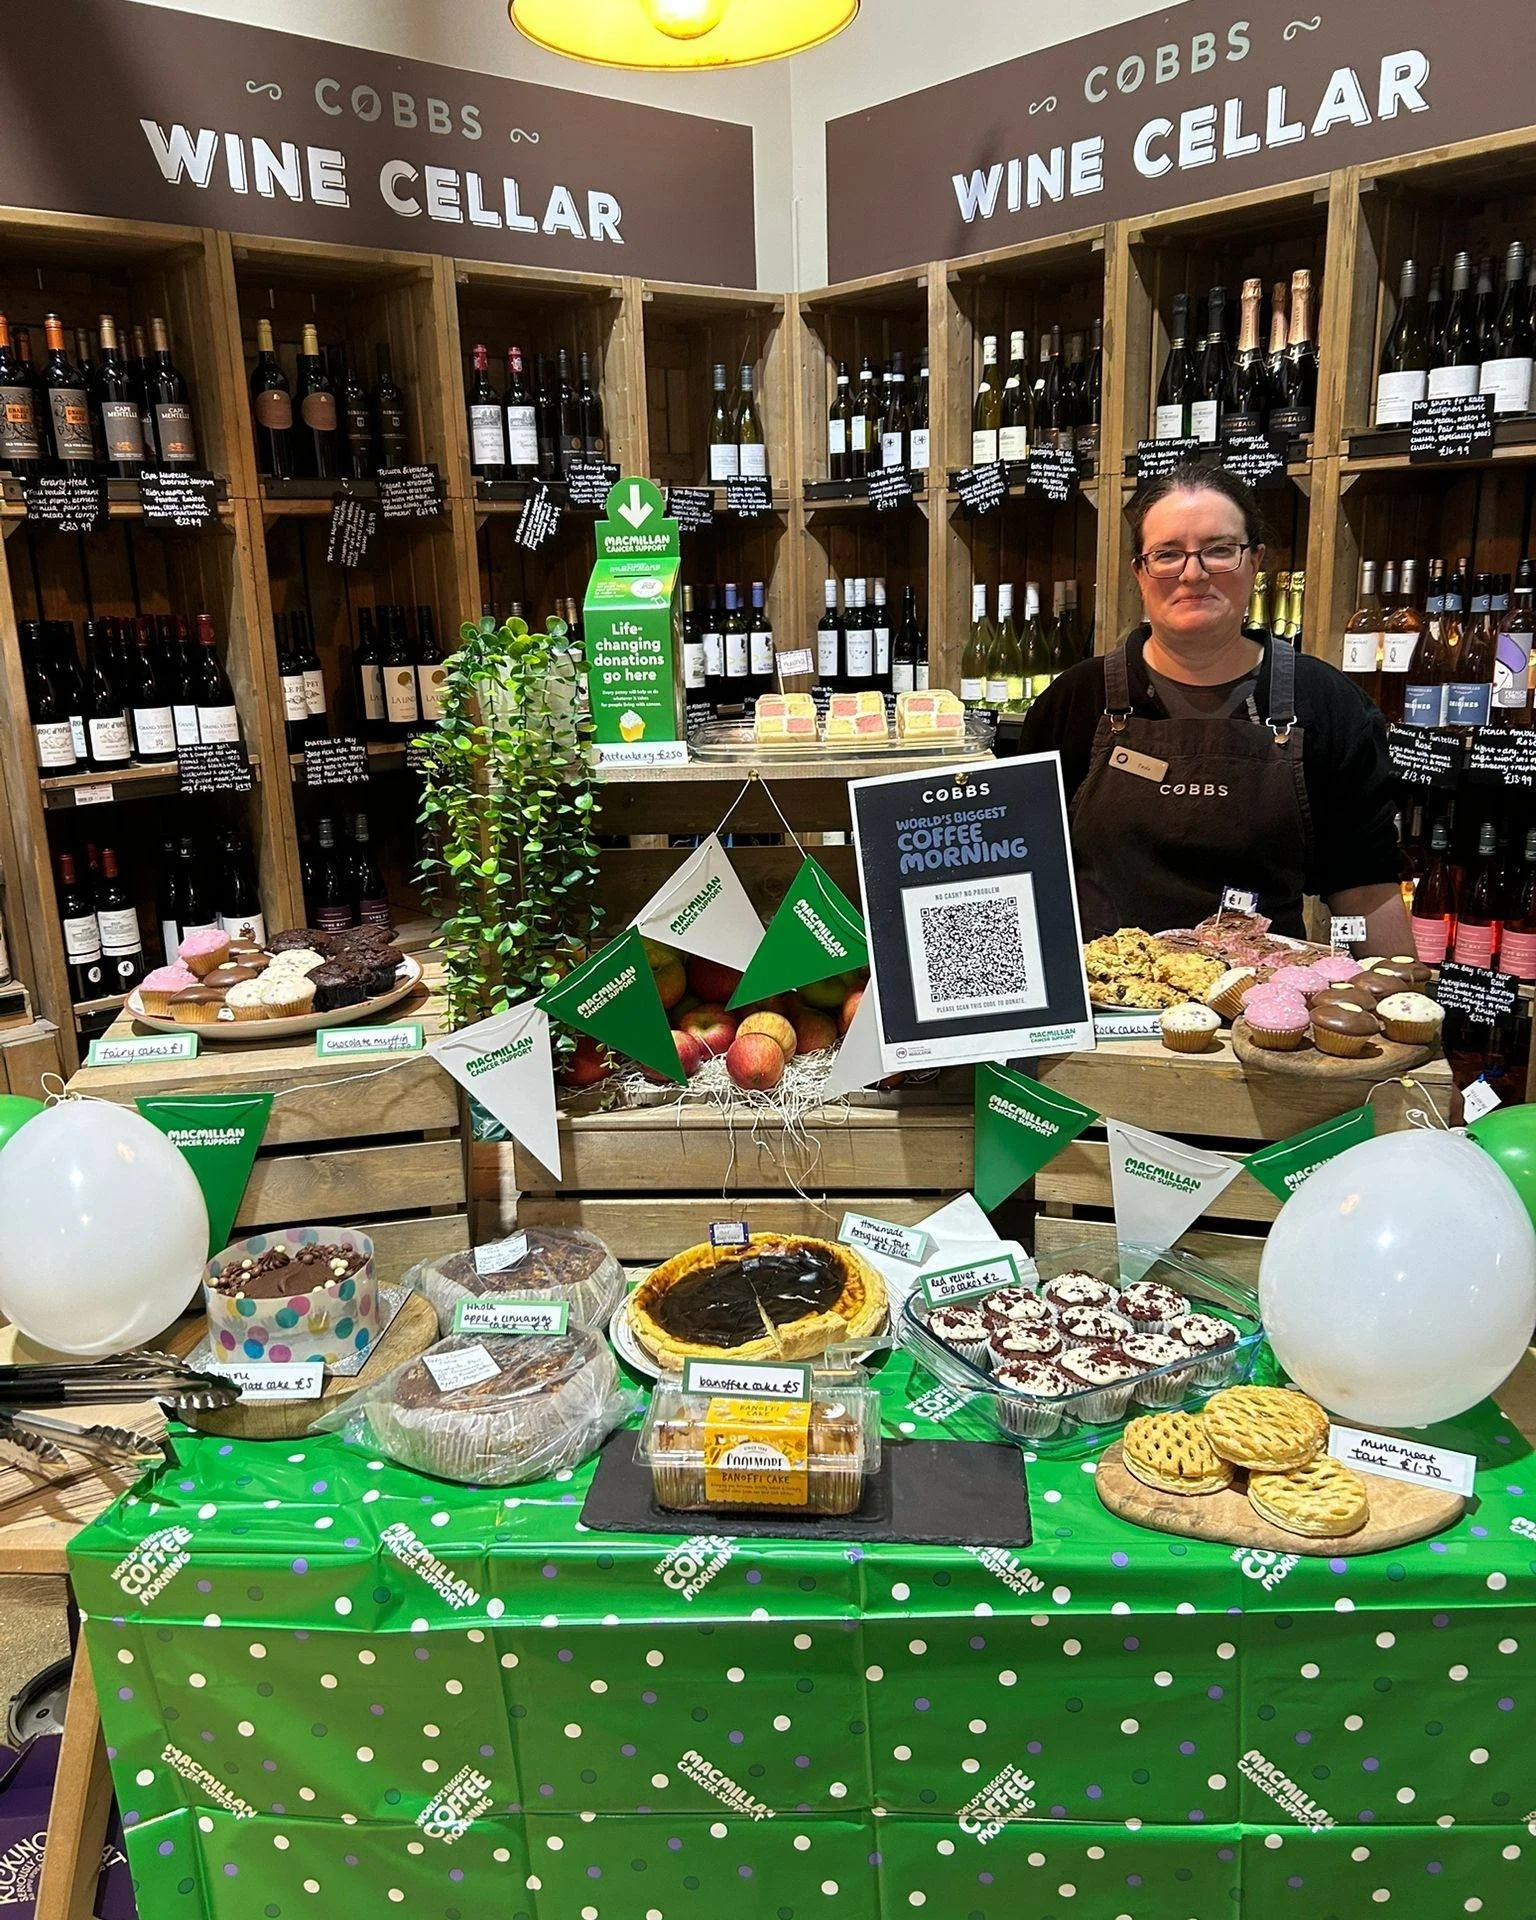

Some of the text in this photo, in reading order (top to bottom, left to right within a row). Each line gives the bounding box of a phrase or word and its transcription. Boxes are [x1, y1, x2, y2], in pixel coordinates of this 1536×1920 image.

[1084, 21, 1251, 104] COBBS
[314, 77, 483, 142] COBBS
[951, 48, 1431, 224] WINE CELLAR
[139, 117, 626, 245] WINE CELLAR
[604, 534, 670, 547] MACMILLAN
[606, 544, 667, 553] CANCER SUPPORT
[595, 637, 661, 653] changing
[611, 622, 642, 635] Life-
[594, 653, 664, 667] donations
[603, 668, 656, 684] go here
[1414, 740, 1433, 751] Rosé
[922, 783, 990, 803] COBBS
[1159, 783, 1229, 797] COBBS
[896, 805, 1007, 831] WORLD'S BIGGEST
[897, 822, 983, 852] COFFEE
[900, 838, 1028, 875] MORNING
[670, 876, 722, 933] MACMILLAN
[677, 885, 724, 936] CANCER SUPPORT
[792, 905, 839, 958] CANCER SUPPORT
[796, 899, 848, 958] MACMILLAN
[576, 965, 636, 1015] MACMILLAN
[583, 974, 637, 1020] CANCER SUPPORT
[937, 1004, 955, 1013] PLEASE
[956, 1003, 970, 1011] SCAN
[971, 1002, 982, 1010] THIS
[983, 1001, 997, 1009] CODE
[327, 1036, 371, 1050] chocolate
[1029, 1028, 1076, 1039] MACMILLAN
[1117, 1024, 1149, 1035] cakes
[100, 1047, 135, 1064] fairy
[138, 1045, 168, 1059] cakes
[466, 1036, 534, 1072] MACMILLAN
[471, 1044, 533, 1078] CANCER SUPPORT
[987, 1102, 1053, 1138] CANCER SUPPORT
[989, 1094, 1059, 1134] MACMILLAN
[168, 1127, 245, 1140] MACMILLAN
[203, 1135, 241, 1147] SUPPORT
[1124, 1166, 1196, 1195] CANCER SUPPORT
[1125, 1157, 1202, 1190] MACMILLAN
[860, 1218, 904, 1238] Homemade
[931, 1270, 976, 1288] Red velvet
[464, 1315, 490, 1326] apple
[490, 1321, 518, 1331] cake
[266, 1380, 290, 1390] cake
[699, 1375, 801, 1394] banoffee cake £5
[740, 1405, 781, 1413] BANOFFI
[721, 1472, 791, 1484] BANOFFI CAKE
[1350, 1448, 1442, 1478] tart £1.50
[120, 1526, 194, 1595] COFFEE
[380, 1529, 465, 1611] CANCER SUPPORT
[388, 1521, 480, 1607] MACMILLAN
[977, 1551, 1029, 1597] SUPPORT
[139, 1551, 191, 1606] MORNING
[160, 1751, 246, 1821] CANCER SUPPORT
[165, 1743, 258, 1819] MACMILLAN
[676, 1760, 718, 1795] CANCER
[682, 1749, 777, 1819] MACMILLAN
[983, 1763, 1016, 1796] BIGGEST
[1237, 1759, 1278, 1798] CANCER
[1243, 1749, 1339, 1830] MACMILLAN
[414, 1764, 472, 1827] WORLD'S BIGGEST
[423, 1769, 492, 1838] COFFEE
[958, 1769, 1036, 1834] COFFEE
[442, 1795, 494, 1846] MORNING
[16, 1857, 36, 1903] SERIOUSLY
